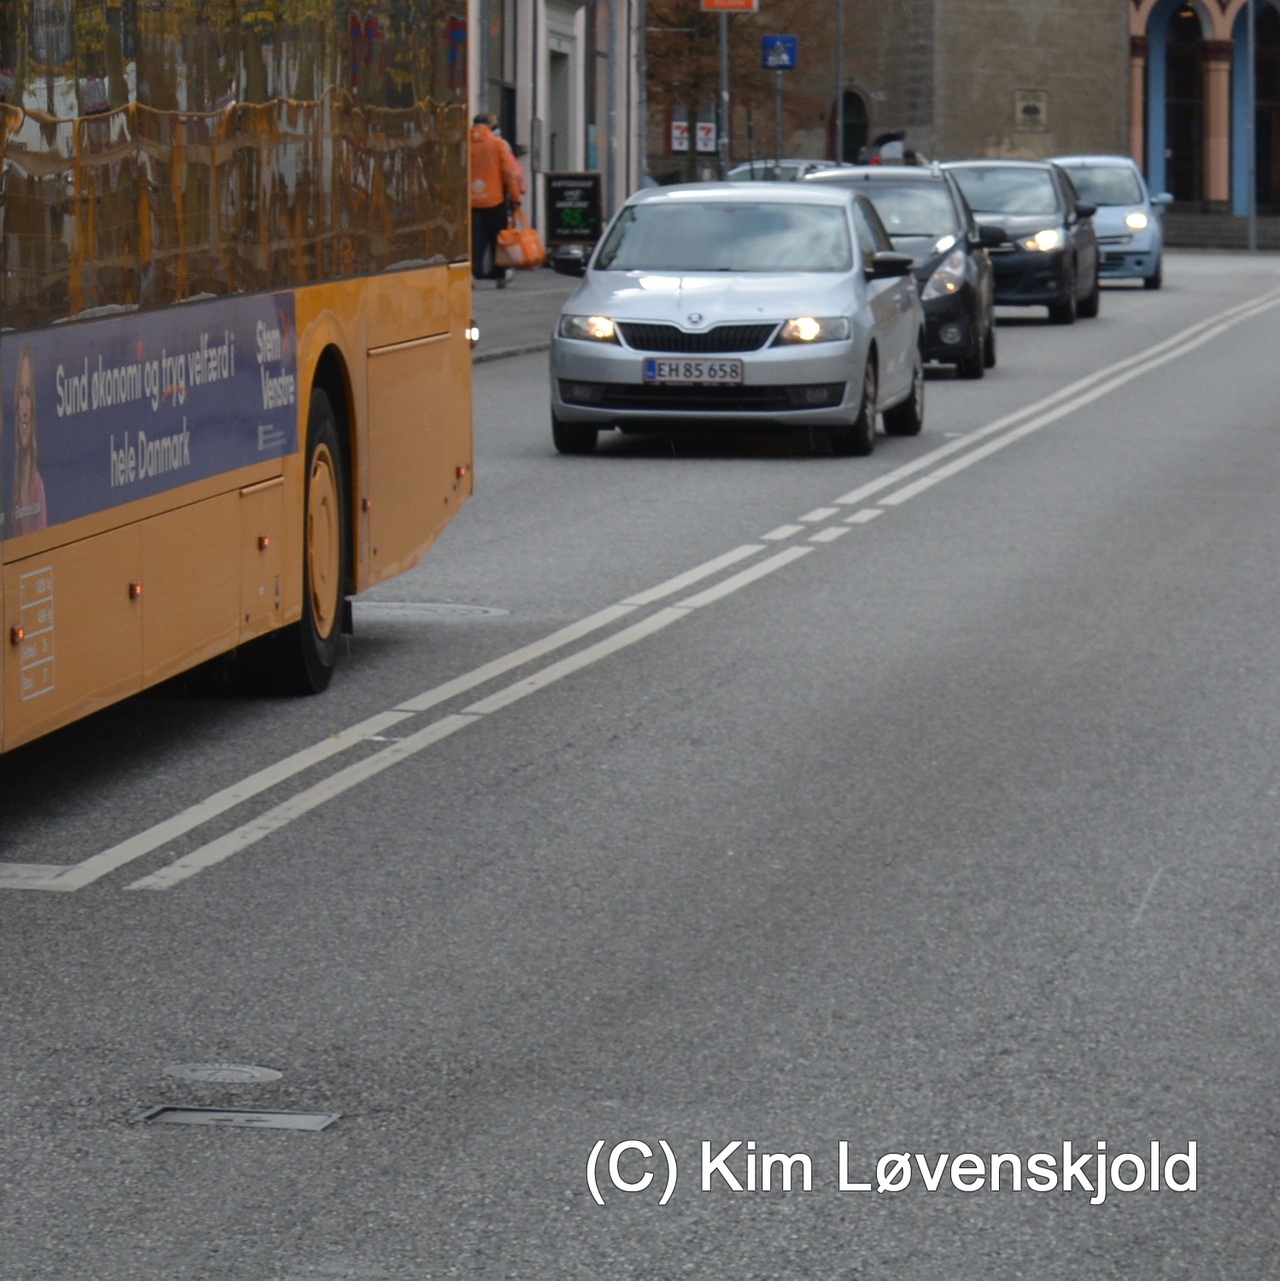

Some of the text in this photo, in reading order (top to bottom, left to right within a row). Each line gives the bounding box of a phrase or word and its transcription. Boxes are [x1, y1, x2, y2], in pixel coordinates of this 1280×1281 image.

[256, 319, 281, 364] Stem
[56, 330, 235, 417] Sund økonomi og tryg velfærd i
[261, 364, 295, 410] Venstre
[657, 362, 739, 379] EH 85 658
[111, 431, 136, 487] hele
[138, 416, 190, 479] Danmark
